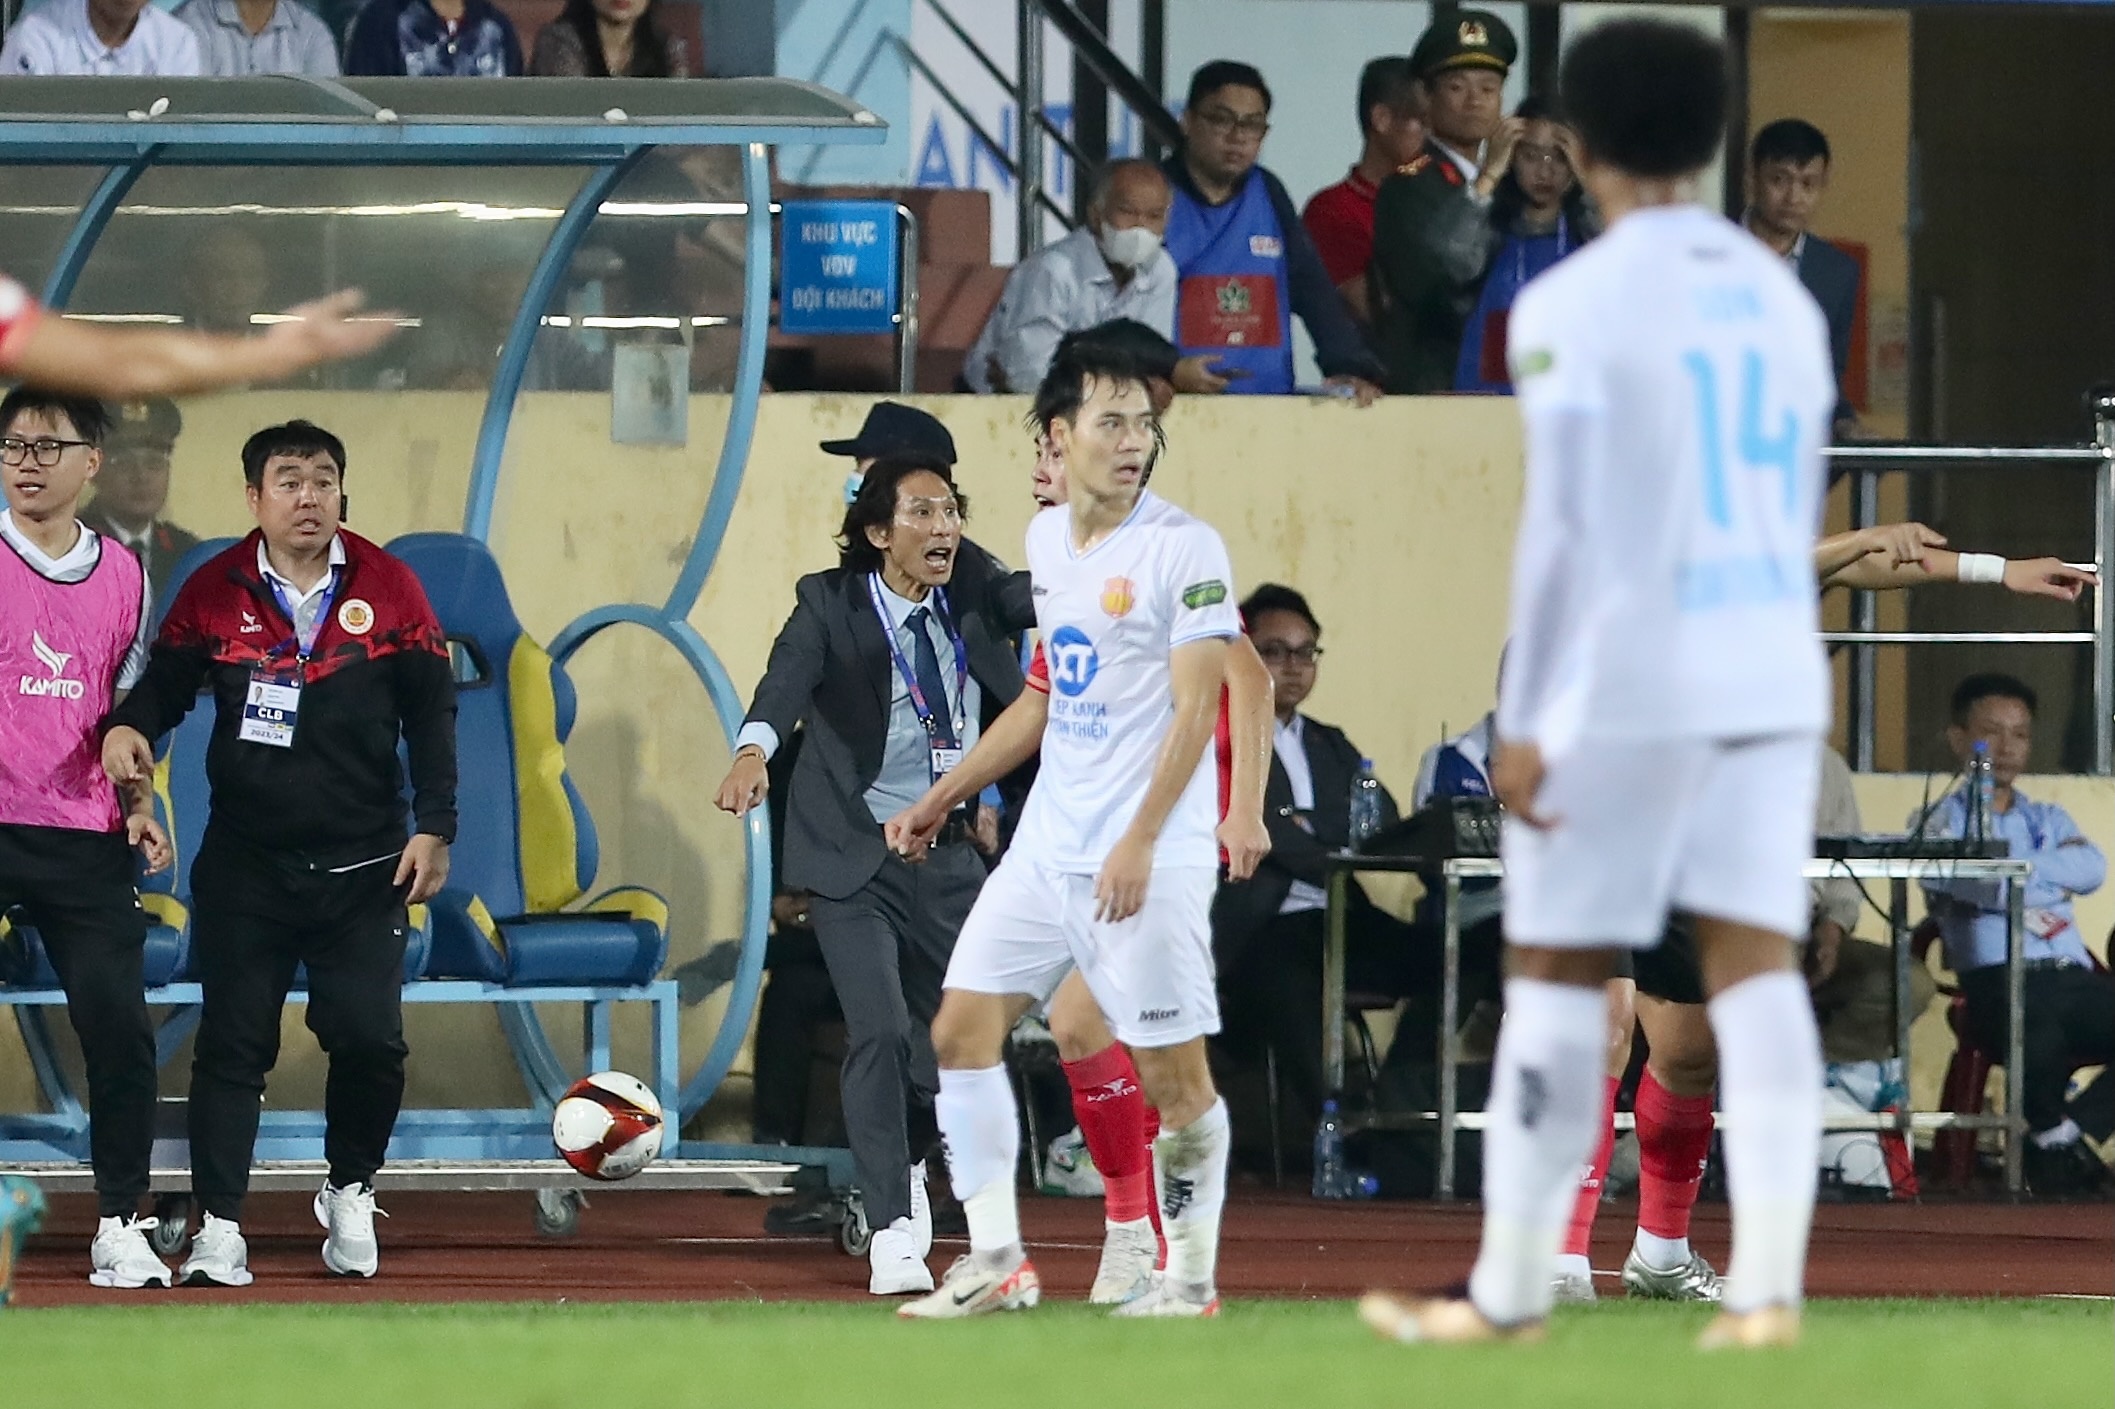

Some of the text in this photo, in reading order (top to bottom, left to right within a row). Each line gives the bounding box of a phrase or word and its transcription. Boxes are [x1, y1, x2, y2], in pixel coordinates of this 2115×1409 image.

[801, 221, 839, 244] KHU
[1678, 348, 1804, 530] 14
[19, 674, 85, 700] KAMITO
[257, 706, 284, 722] CLB
[250, 728, 284, 741] 2023/24
[1138, 1008, 1180, 1023] Mitre
